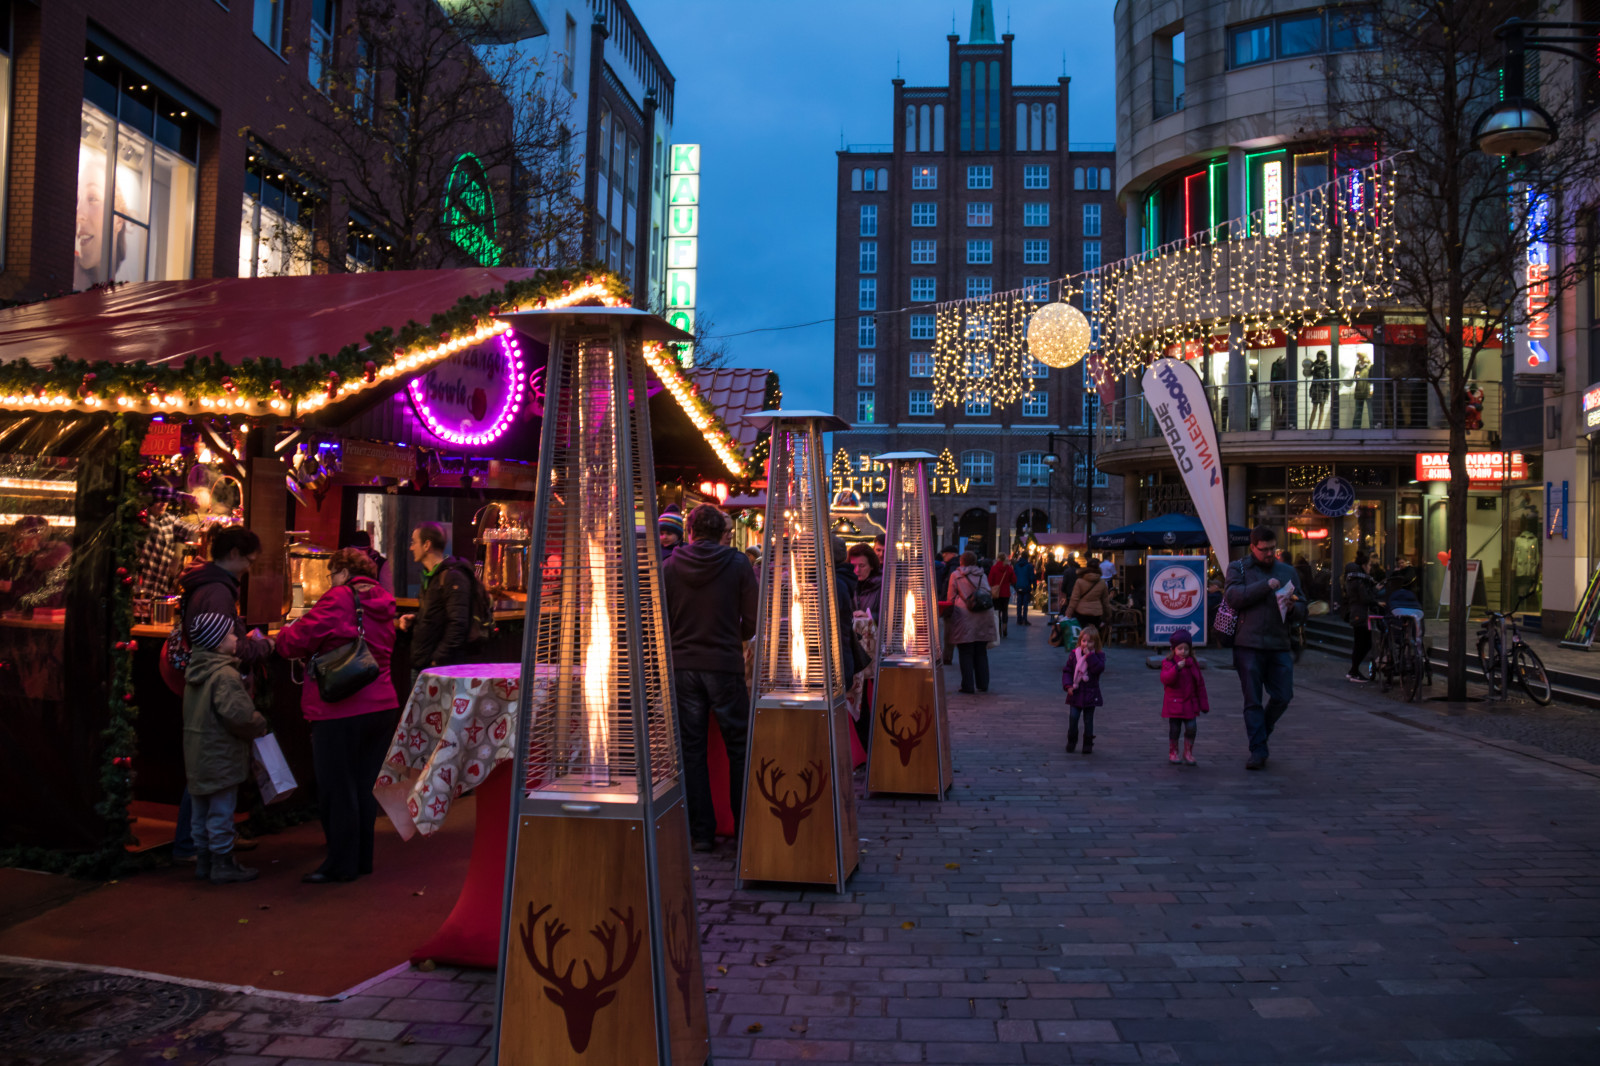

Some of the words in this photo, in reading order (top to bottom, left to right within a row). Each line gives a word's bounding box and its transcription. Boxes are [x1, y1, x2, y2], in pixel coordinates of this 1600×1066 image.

[148, 424, 177, 434] owle
[1422, 453, 1523, 467] DANMOE
[1422, 468, 1452, 479] FASHIO
[1466, 467, 1492, 479] PANY
